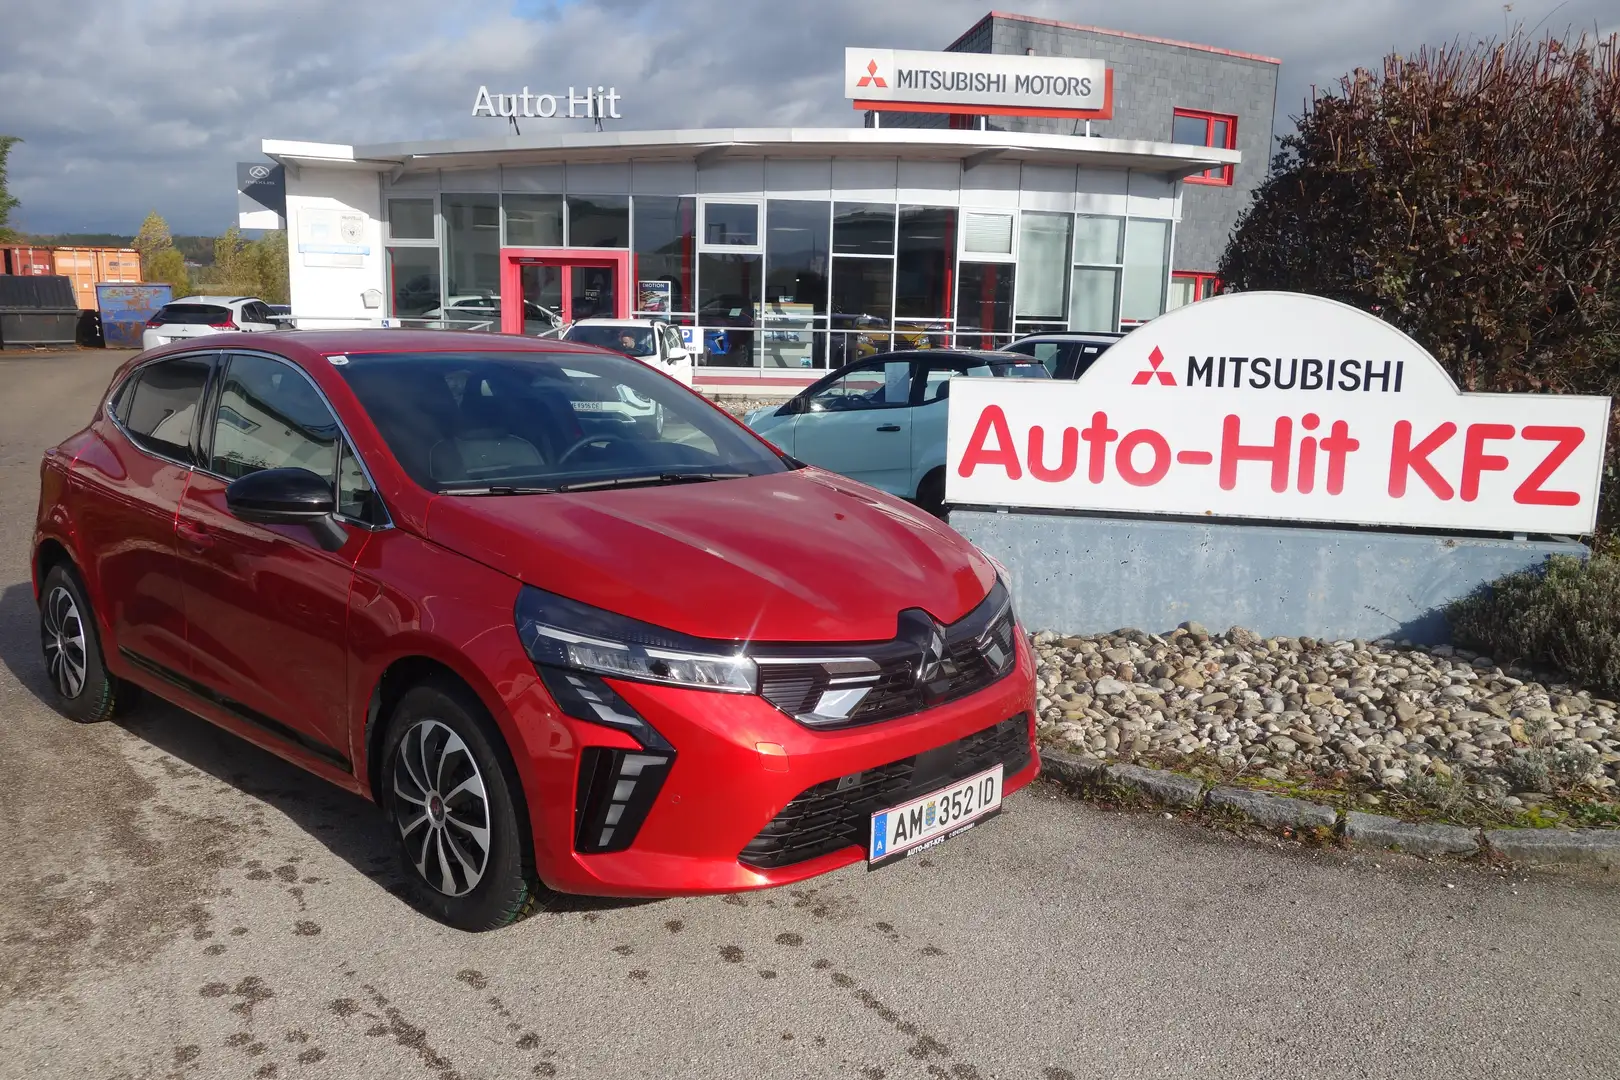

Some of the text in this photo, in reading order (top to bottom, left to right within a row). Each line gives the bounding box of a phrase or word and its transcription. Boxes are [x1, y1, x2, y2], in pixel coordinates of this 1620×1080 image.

[897, 69, 1092, 97] MITSUBISHI MOTORS
[471, 85, 621, 119] Auto Hit
[1186, 355, 1404, 393] MITSUBISHI
[957, 403, 1586, 507] Auto-Hit KFZ
[892, 776, 994, 845] AM 352 ID
[876, 840, 883, 851] A
